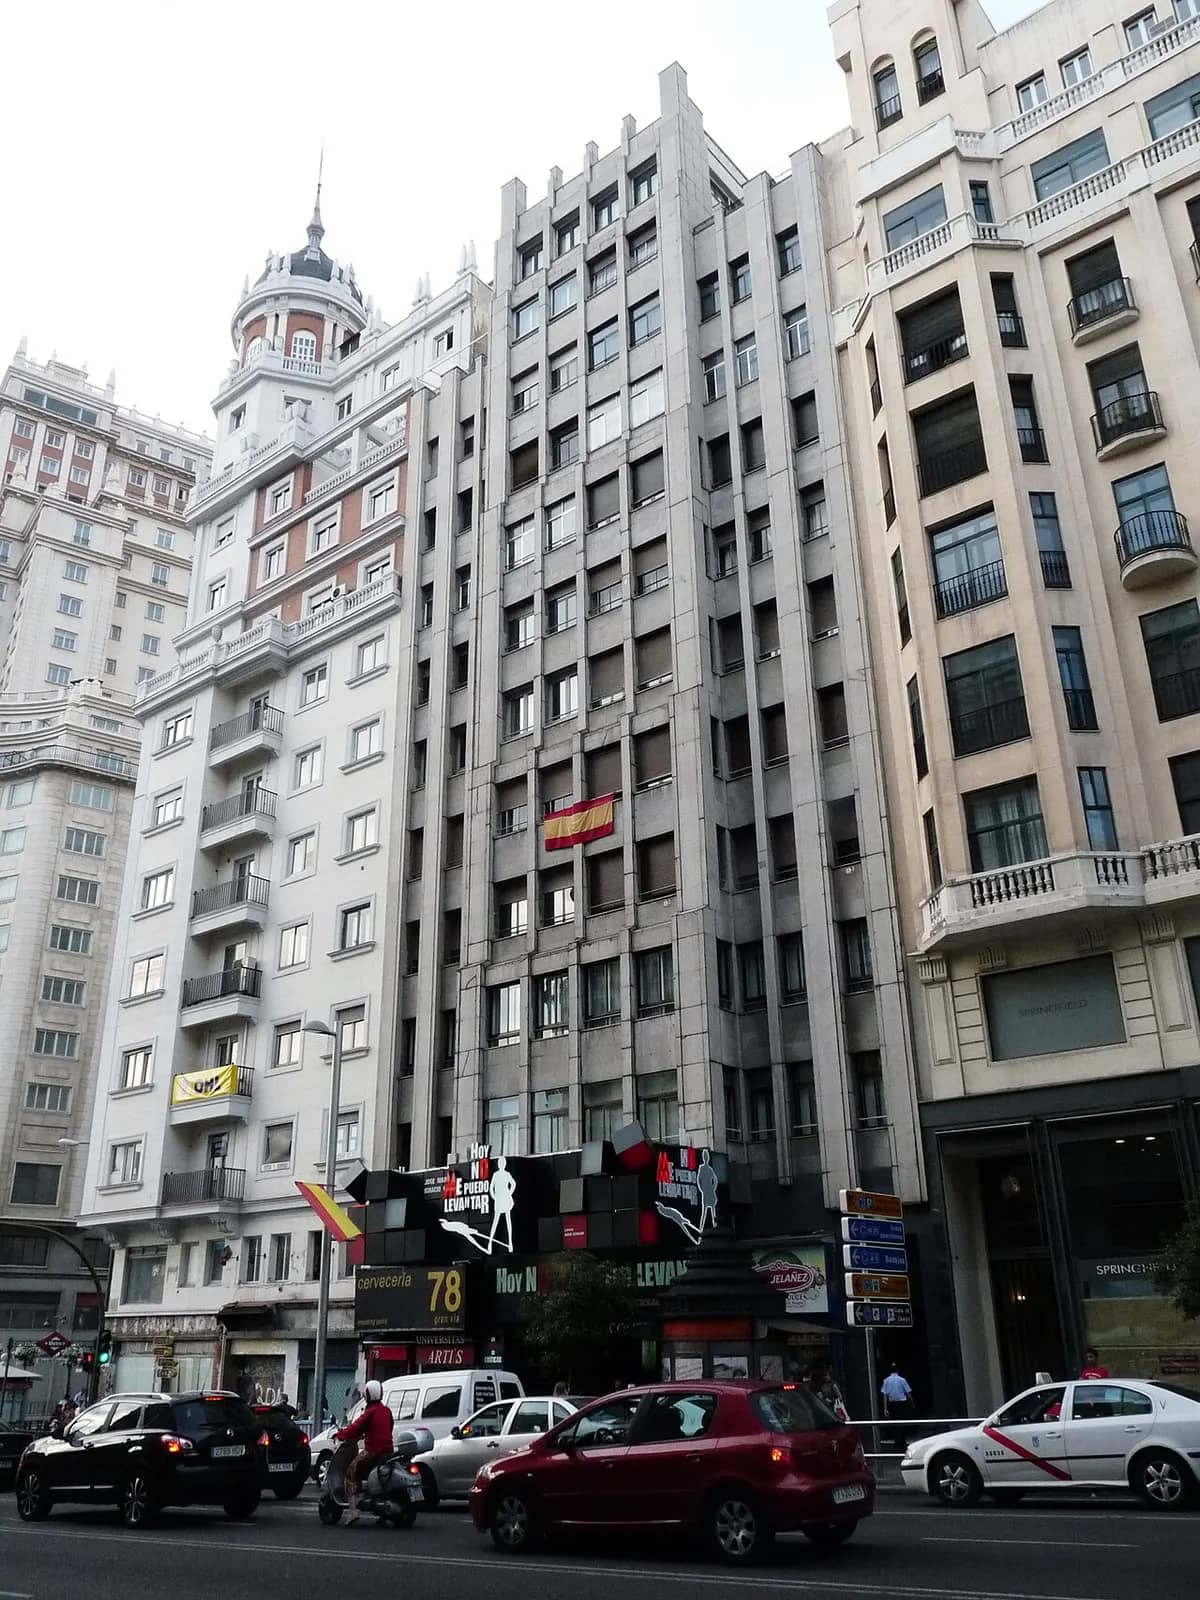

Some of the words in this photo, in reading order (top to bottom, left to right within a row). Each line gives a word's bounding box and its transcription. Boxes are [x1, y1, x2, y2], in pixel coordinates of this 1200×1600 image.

[472, 1158, 489, 1180] NO
[464, 1180, 489, 1195] PUEDO
[444, 1194, 489, 1214] LEVANTAR
[427, 1269, 462, 1313] 78
[416, 1335, 465, 1345] UNIVERSITAS
